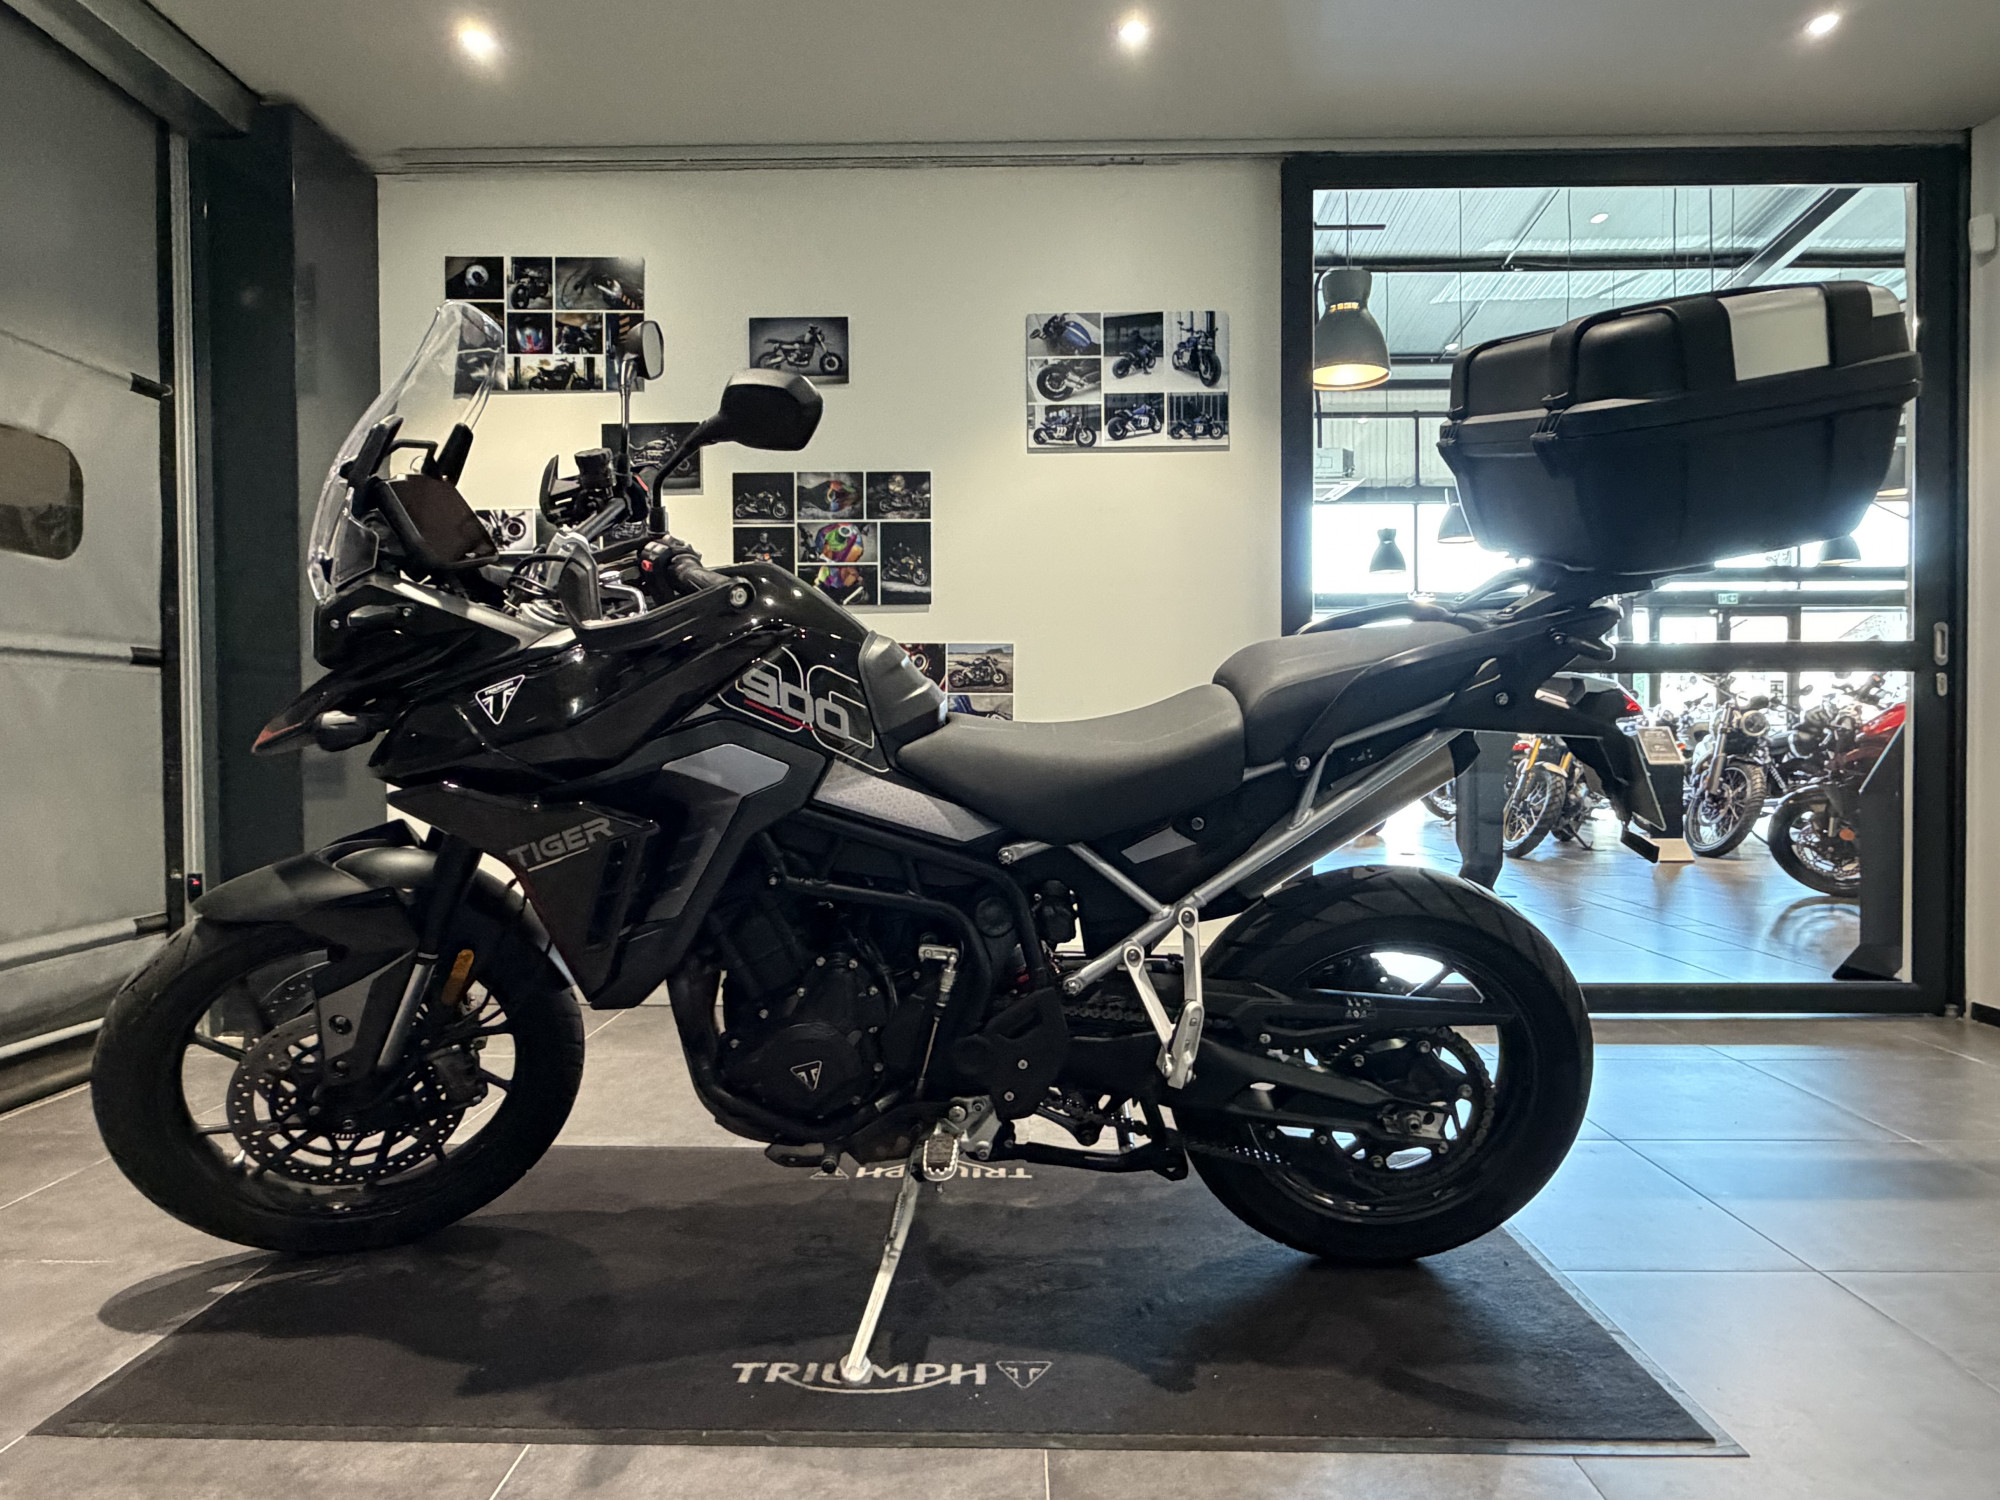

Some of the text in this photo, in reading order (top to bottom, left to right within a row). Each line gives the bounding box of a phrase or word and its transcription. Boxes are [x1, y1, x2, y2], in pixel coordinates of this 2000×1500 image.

[742, 661, 849, 739] 900
[507, 817, 614, 867] TIGER
[856, 1163, 1033, 1179] TRIUPH
